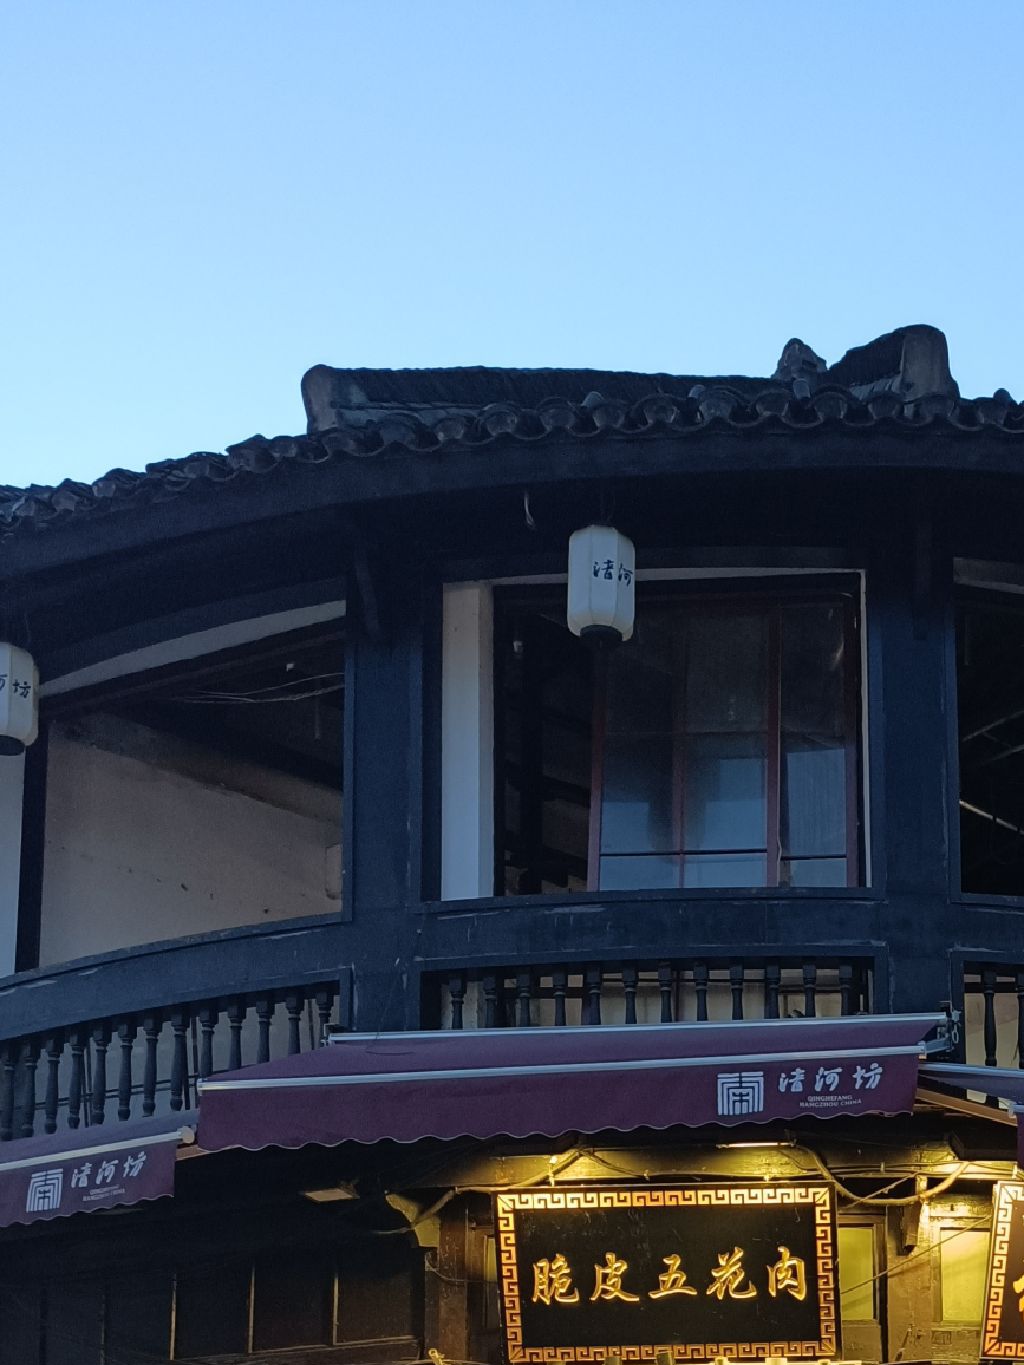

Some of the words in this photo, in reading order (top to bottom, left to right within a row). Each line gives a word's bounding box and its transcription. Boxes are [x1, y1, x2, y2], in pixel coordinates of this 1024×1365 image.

[778, 1063, 882, 1092] 清河坊
[71, 1151, 147, 1188] 清河坊
[533, 1246, 808, 1305] 脆皮五花肉
